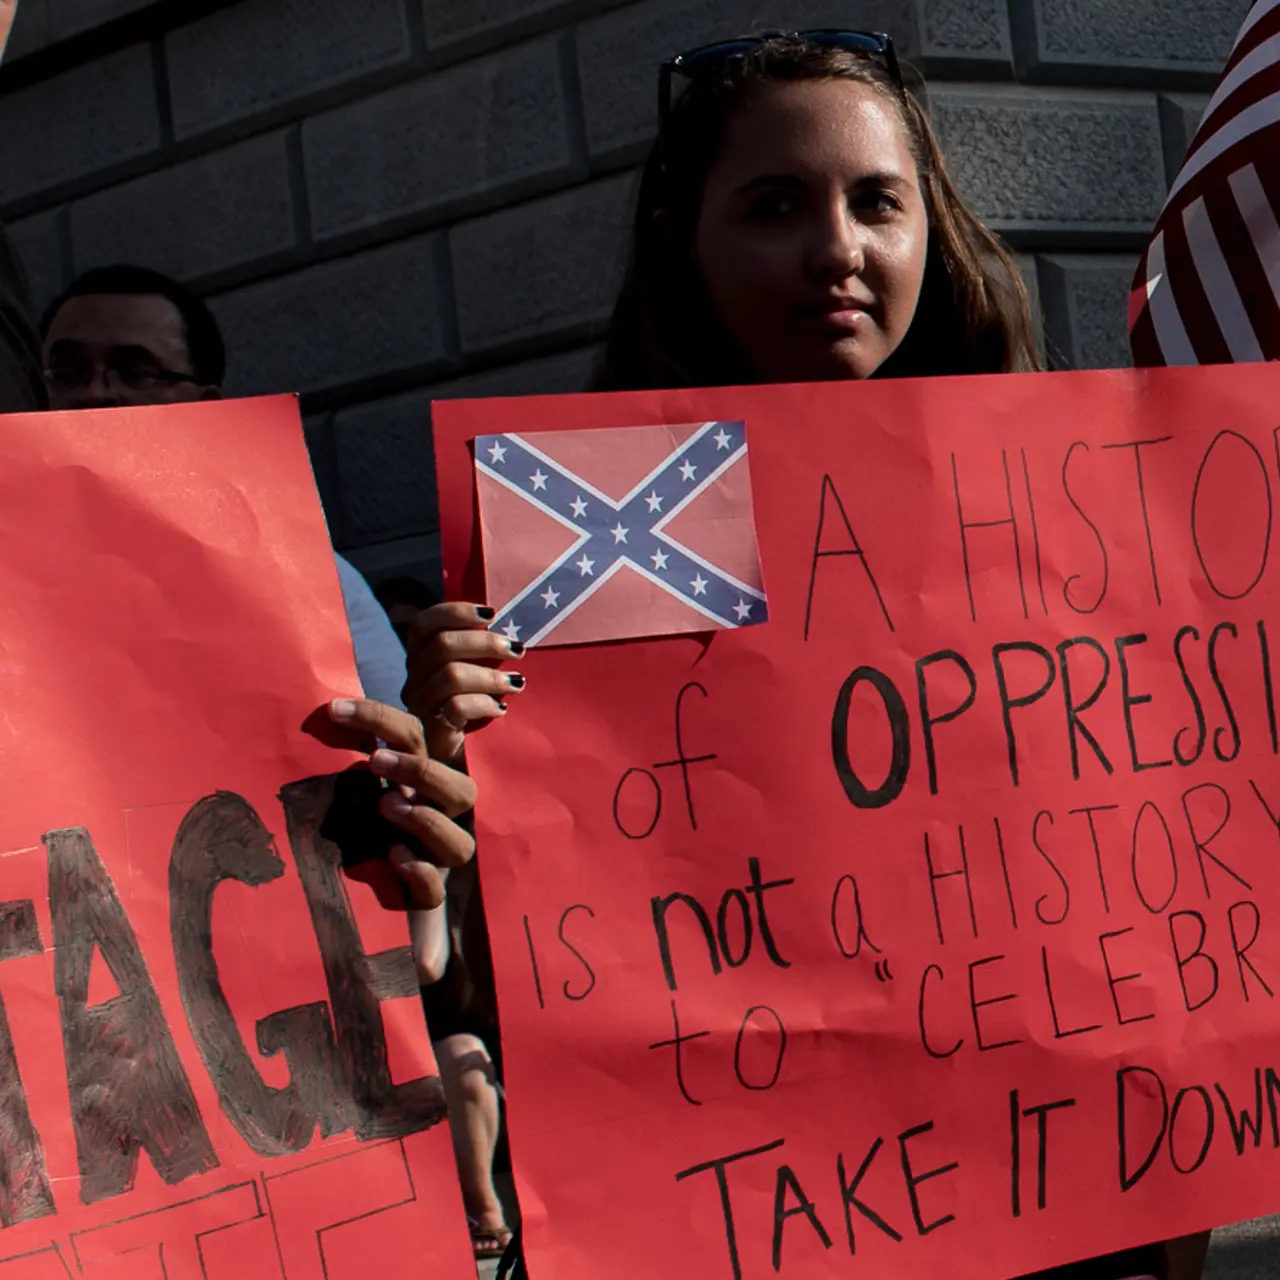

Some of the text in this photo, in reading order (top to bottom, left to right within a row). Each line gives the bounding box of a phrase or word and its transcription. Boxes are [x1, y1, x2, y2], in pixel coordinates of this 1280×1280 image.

[804, 472, 896, 643] A
[611, 681, 718, 841] of
[649, 856, 795, 993] not
[830, 872, 884, 959] a
[648, 995, 788, 1108] to
[1008, 1087, 1076, 1219] IT
